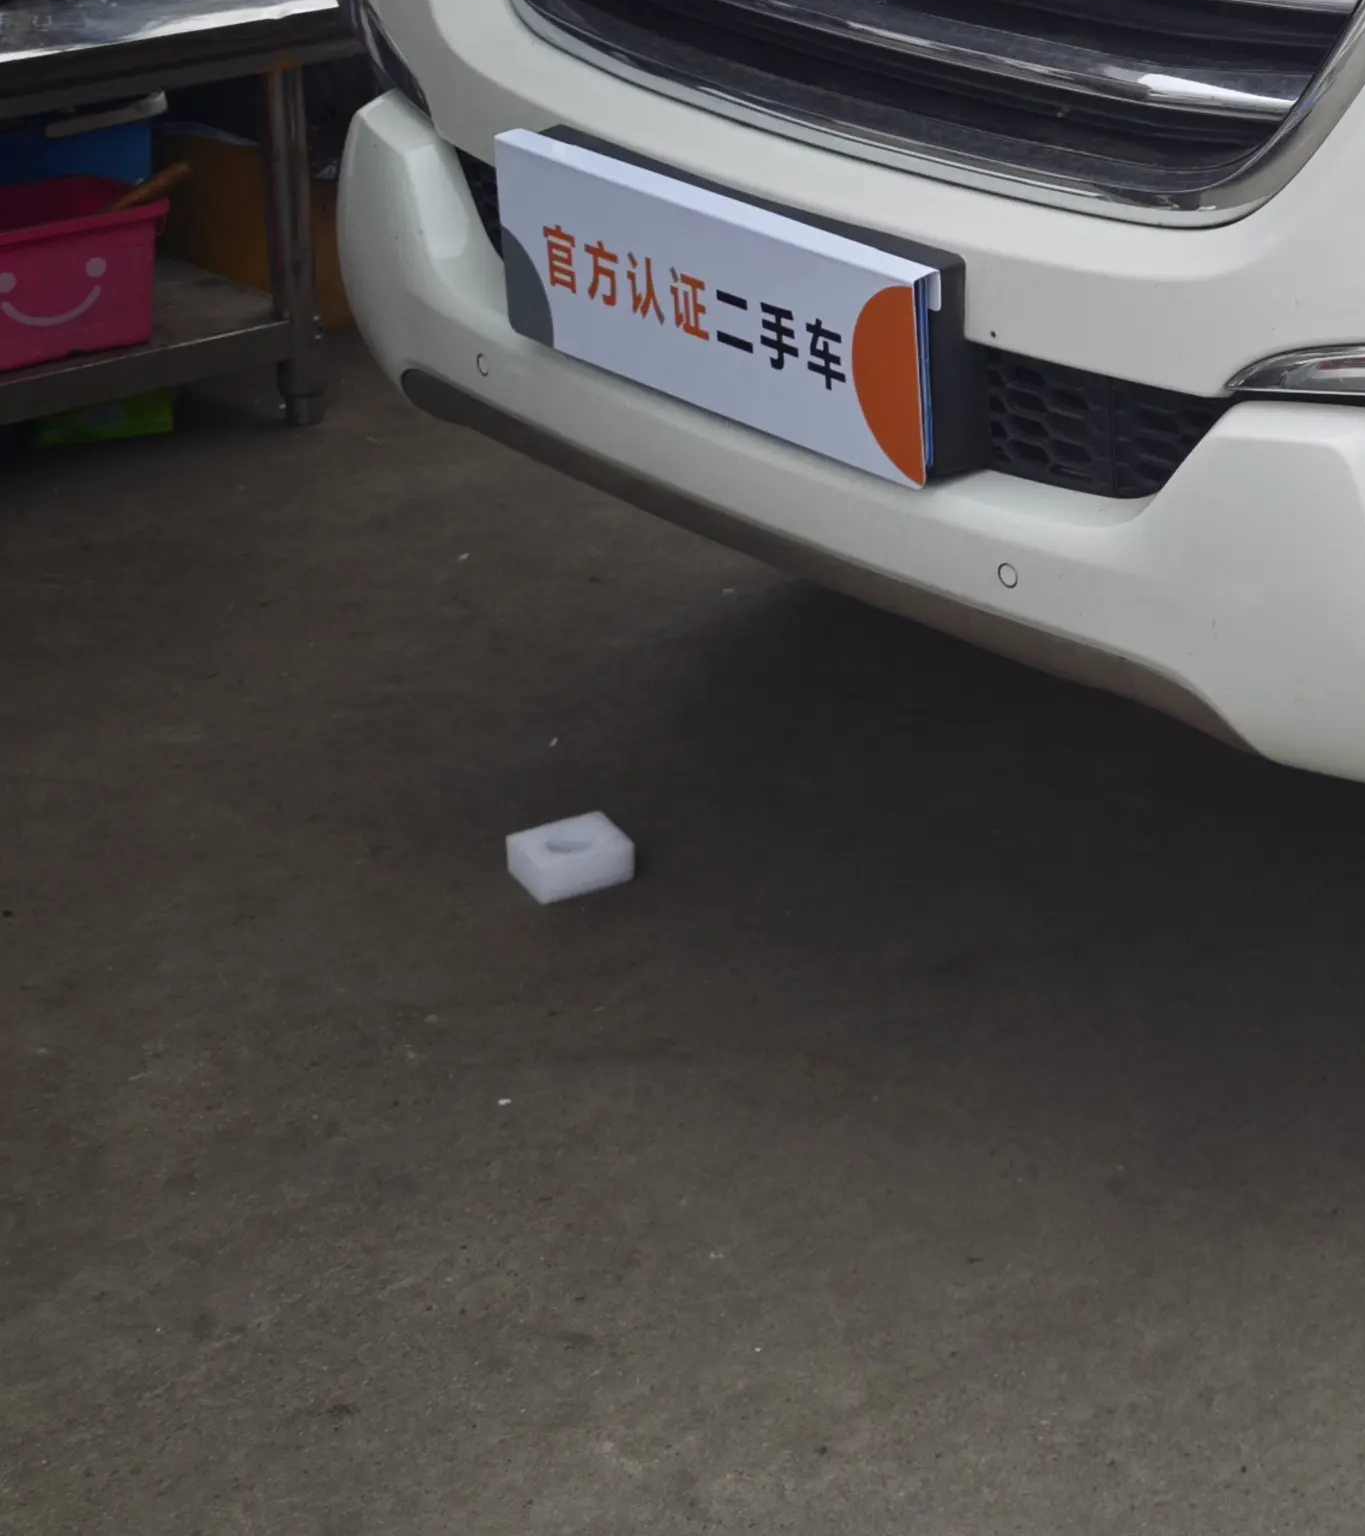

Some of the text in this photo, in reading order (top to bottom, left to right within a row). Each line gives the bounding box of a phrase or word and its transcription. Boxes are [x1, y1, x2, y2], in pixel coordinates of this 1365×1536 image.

[541, 224, 847, 391] 官方认证二手车
